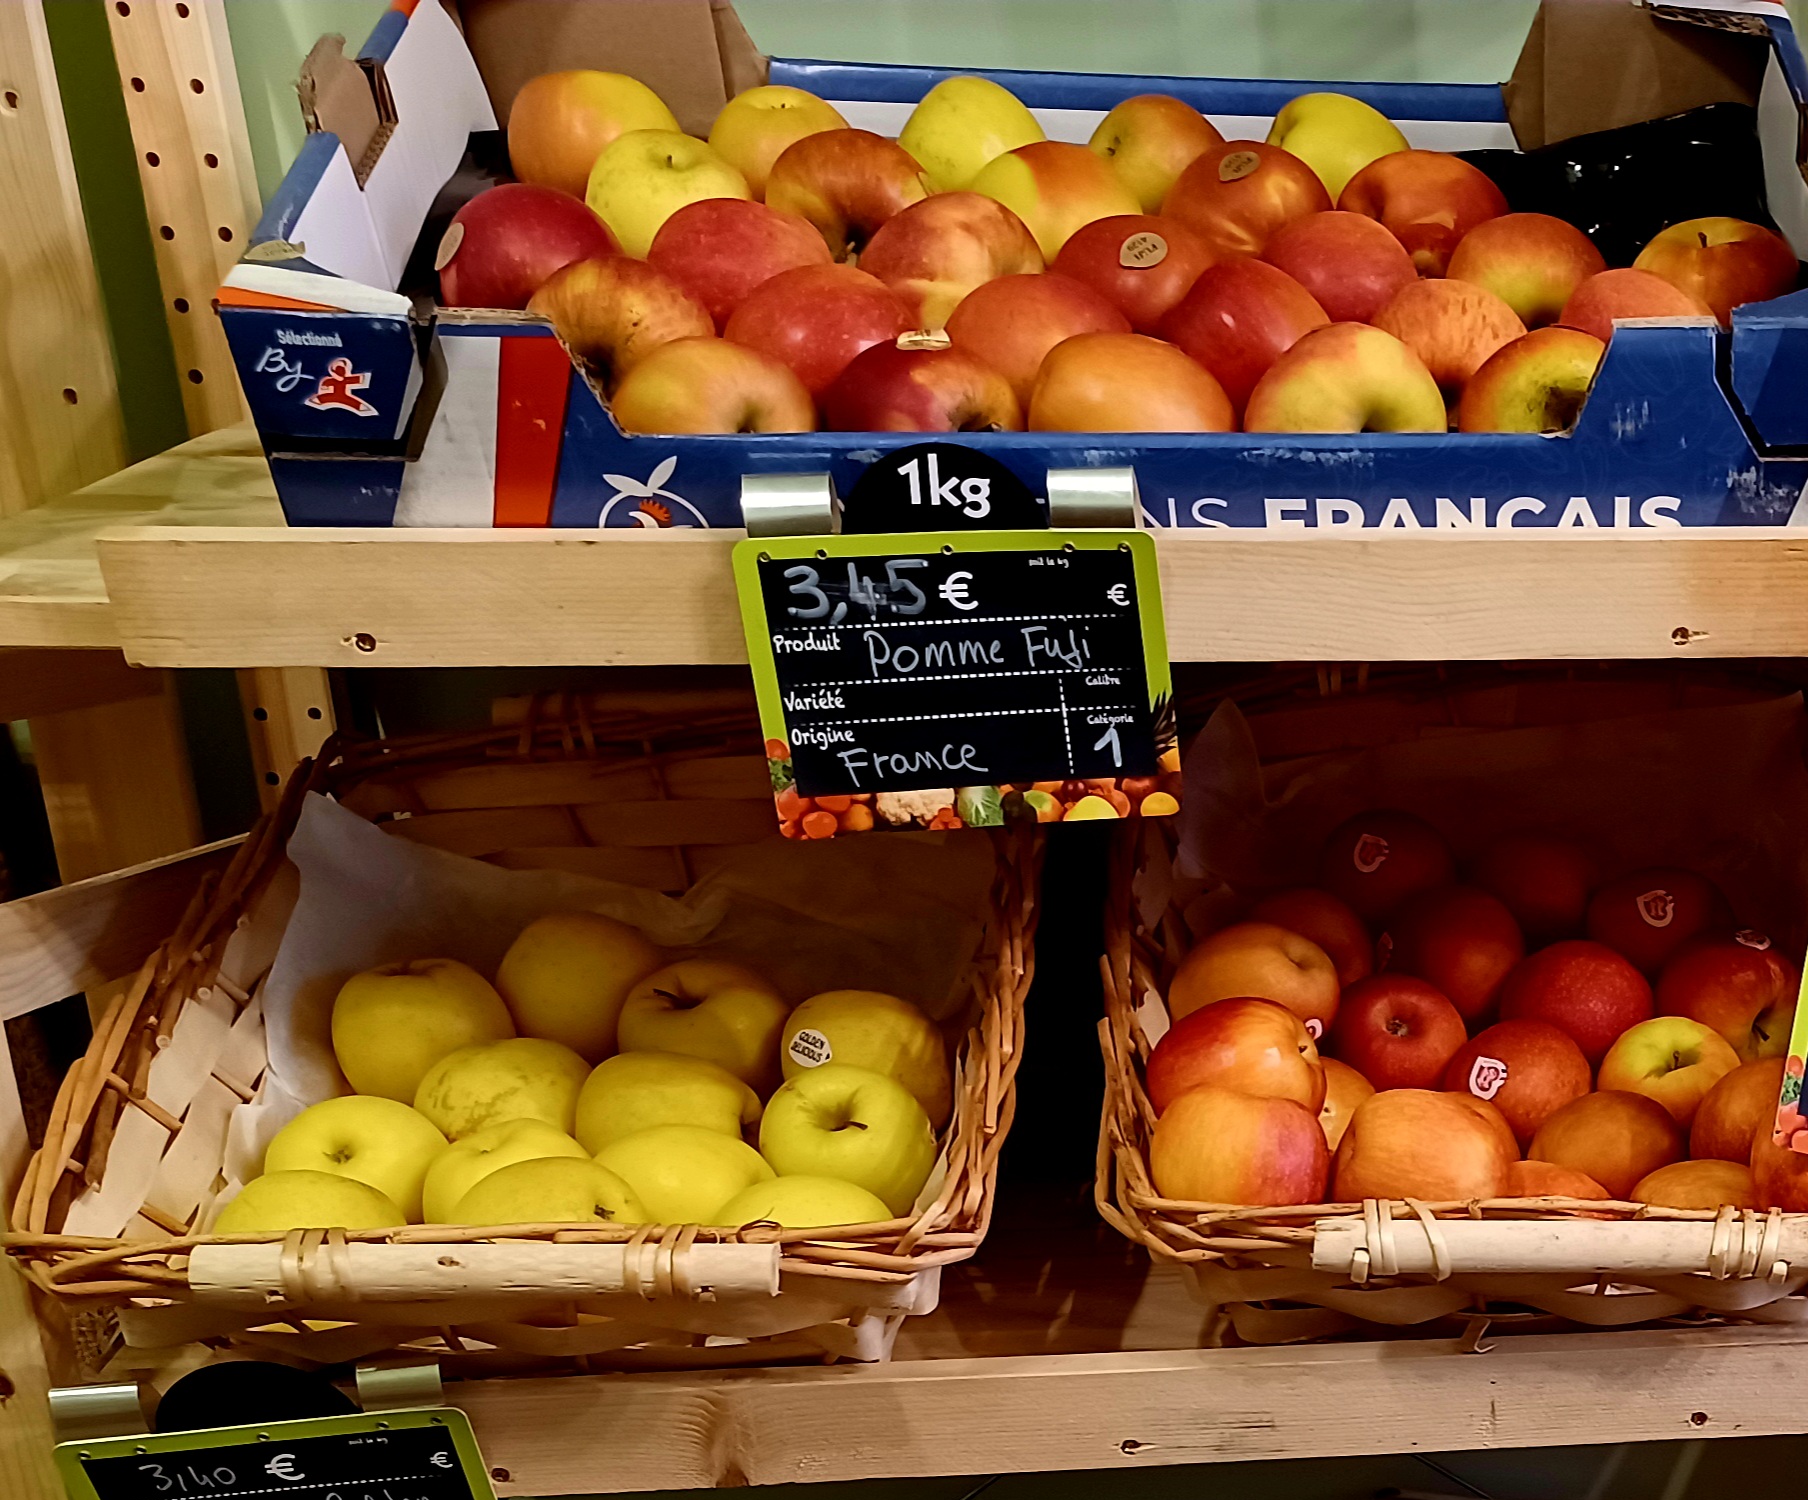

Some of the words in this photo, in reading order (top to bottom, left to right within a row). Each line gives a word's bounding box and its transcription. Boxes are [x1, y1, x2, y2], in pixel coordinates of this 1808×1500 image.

[255, 347, 317, 393] By
[897, 453, 991, 519] 1kg
[938, 571, 979, 611] €
[1107, 583, 1131, 607] €
[773, 635, 841, 655] Produit
[863, 630, 1004, 677] Pomme
[784, 688, 846, 712] Variété
[791, 728, 856, 750] Origine
[1094, 727, 1123, 768] 1
[837, 743, 989, 788] France
[264, 1453, 306, 1481] €
[429, 1451, 455, 1470] €
